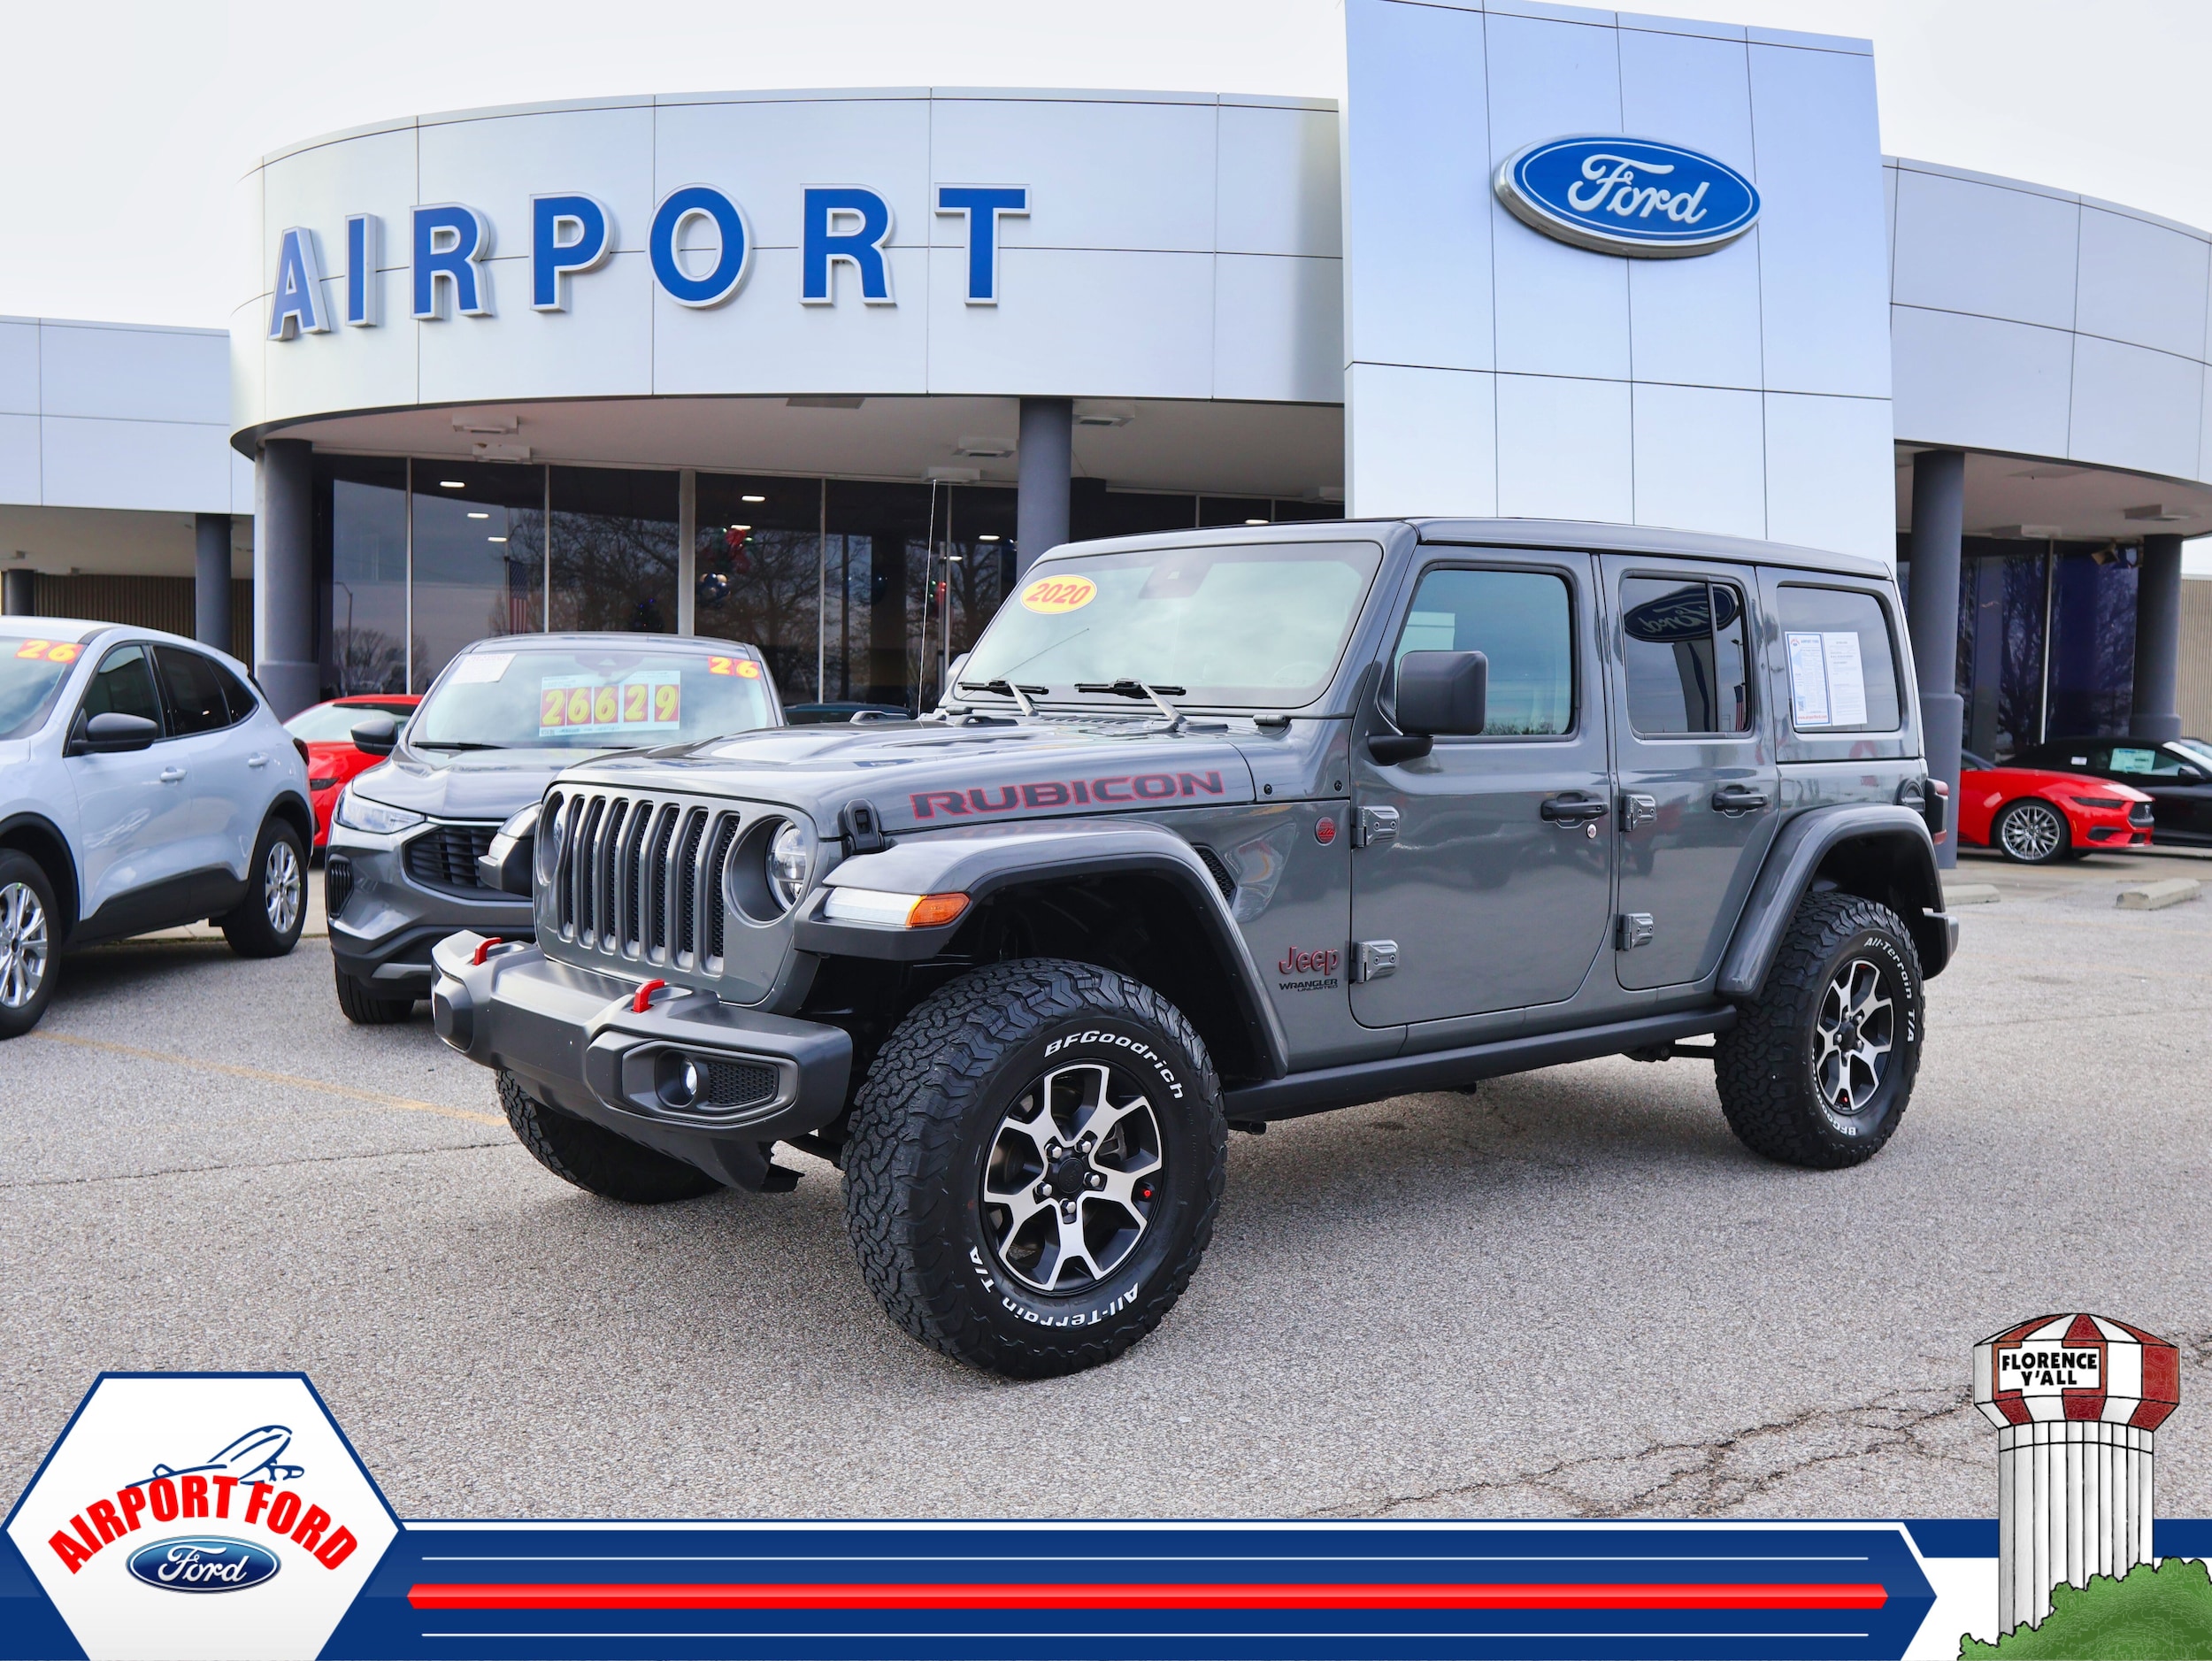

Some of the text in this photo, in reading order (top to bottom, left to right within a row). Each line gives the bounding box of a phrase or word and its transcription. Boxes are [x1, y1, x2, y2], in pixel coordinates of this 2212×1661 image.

[1567, 153, 1709, 224] Ford
[266, 182, 1031, 342] AIRPORT
[1025, 582, 1092, 605] 2020
[16, 641, 81, 663] 26
[710, 657, 759, 678] 26
[541, 684, 680, 727] 26629
[910, 771, 1225, 820] RUBICON
[1279, 946, 1340, 976] Jeep
[1279, 978, 1338, 990] WRANGLER
[1863, 936, 1916, 1043] All-Terrain T/A
[1043, 1029, 1185, 1100] BFGoodrich
[969, 1244, 1141, 1328] All-Terrain T/A
